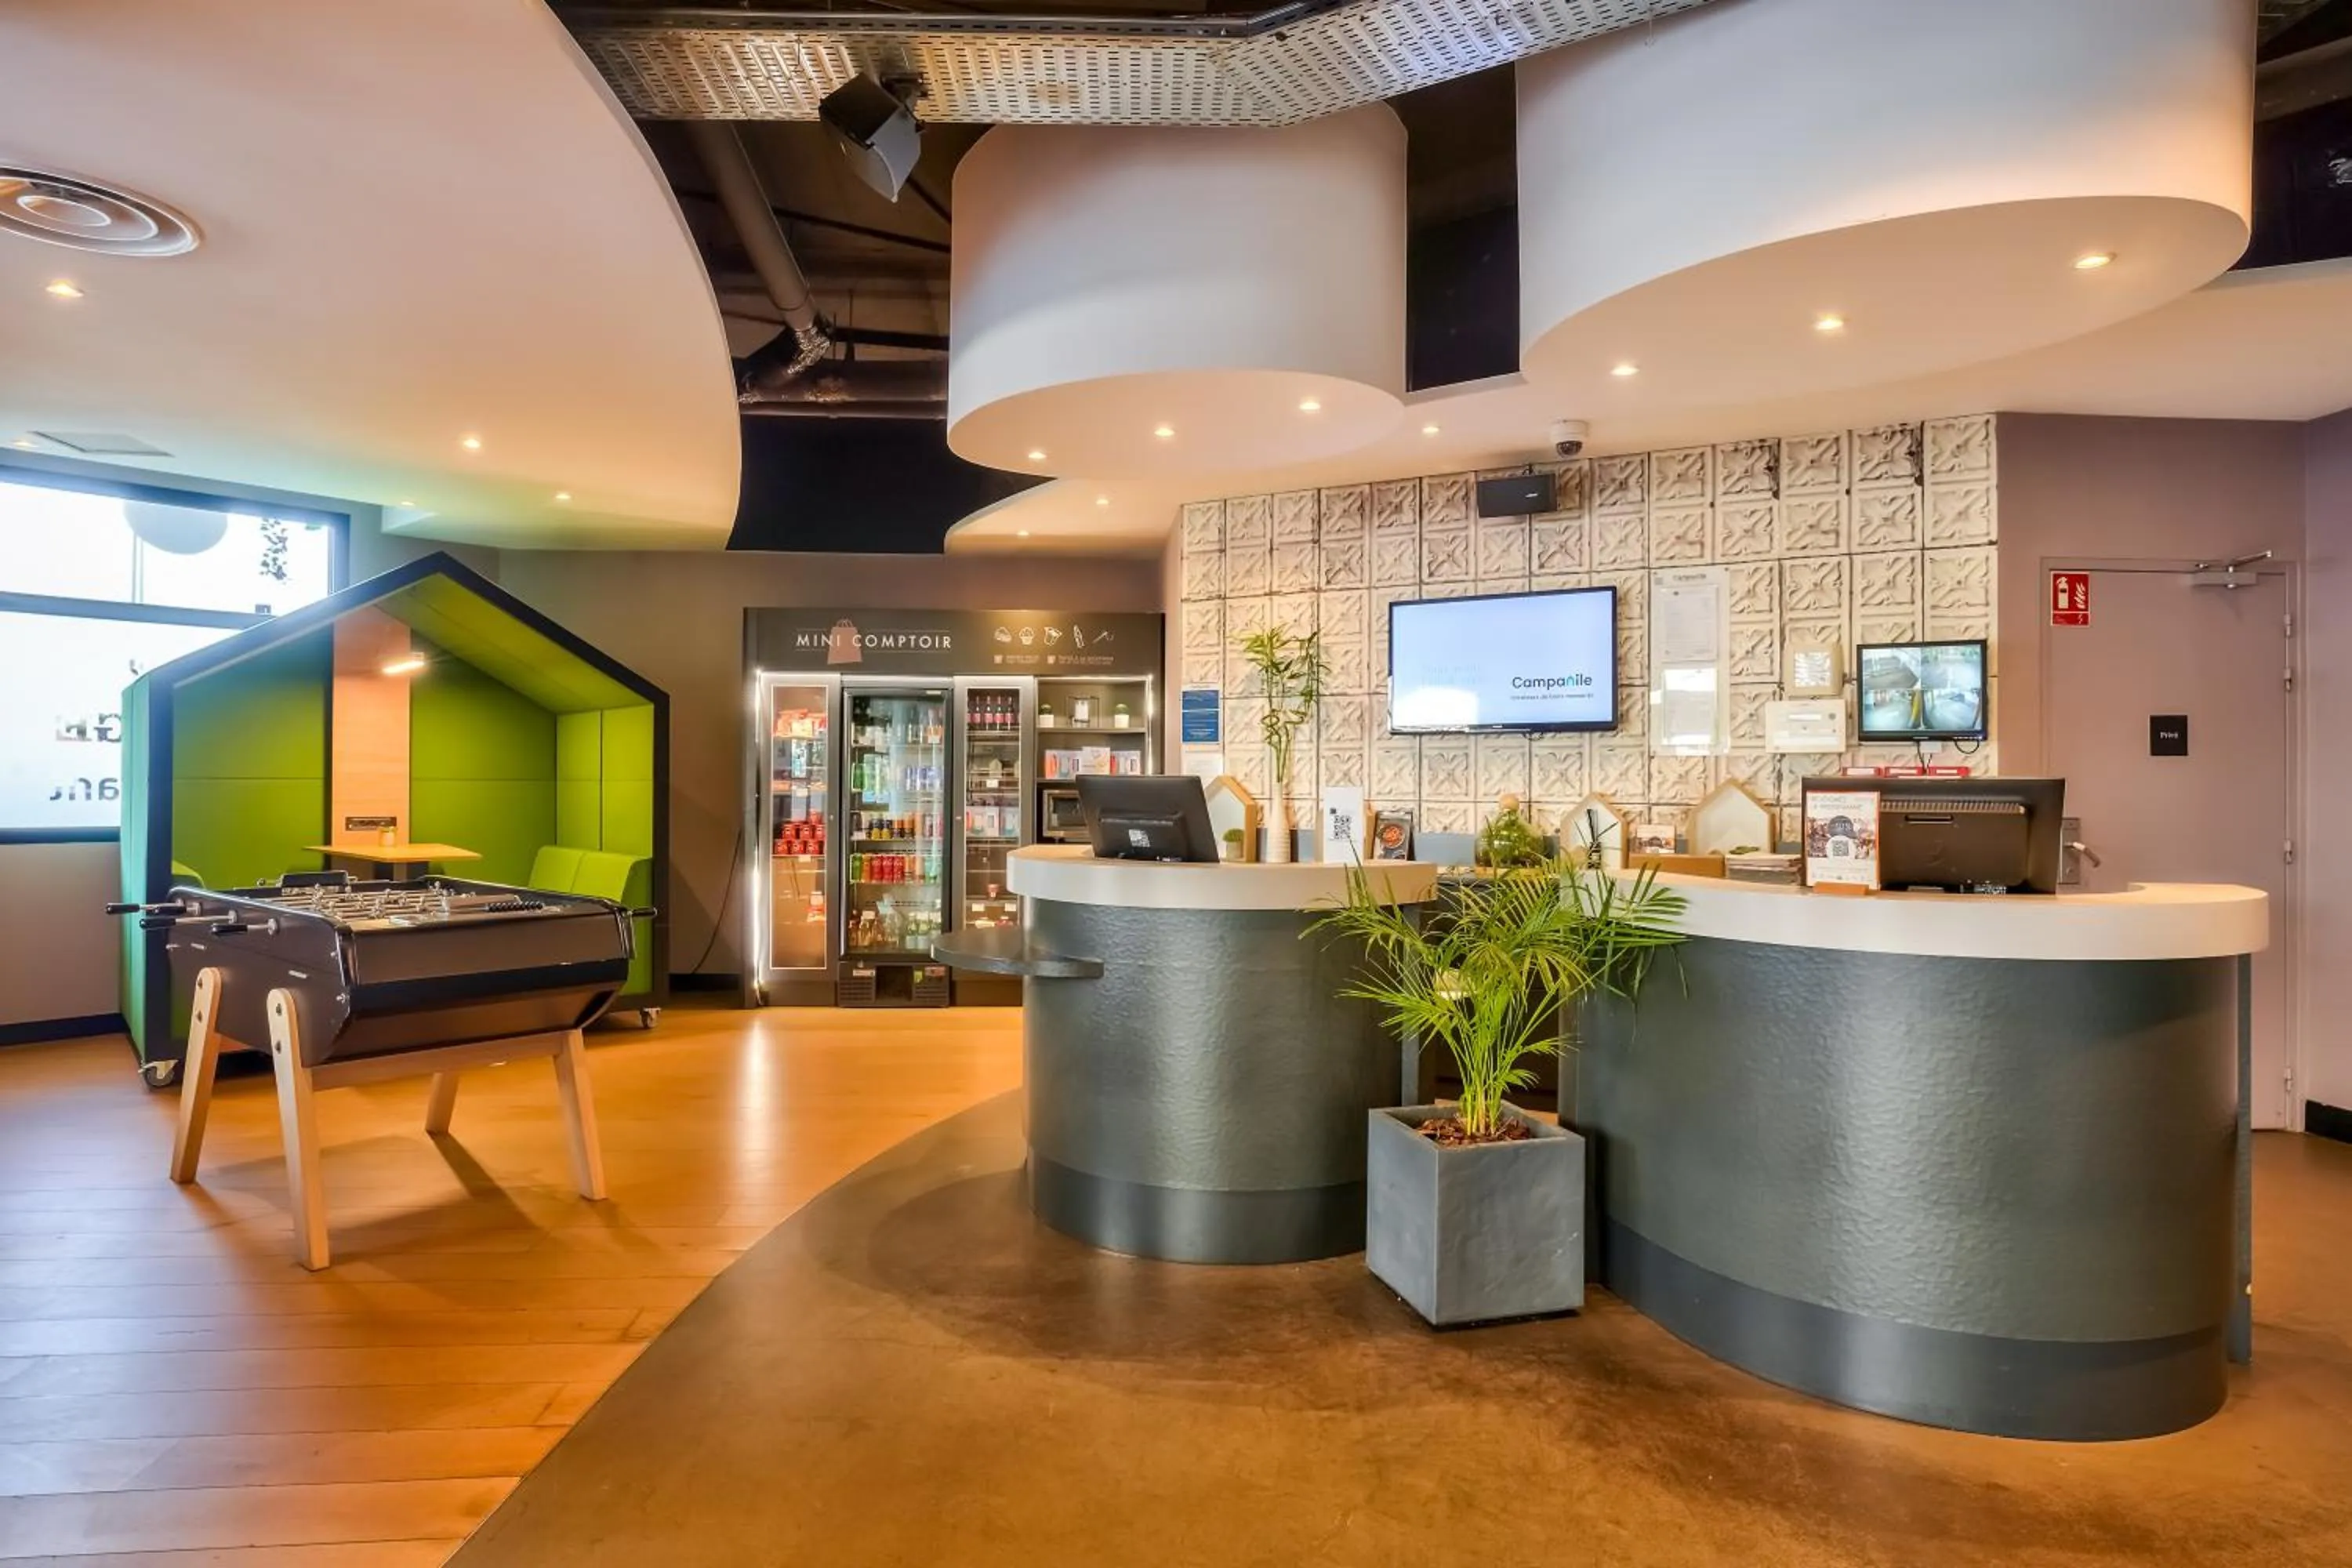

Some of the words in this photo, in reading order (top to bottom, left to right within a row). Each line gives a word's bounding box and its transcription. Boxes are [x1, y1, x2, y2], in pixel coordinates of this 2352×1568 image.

[796, 633, 840, 647] MINI
[852, 634, 952, 648] COMPTOIR
[1512, 673, 1593, 690] Campanile
